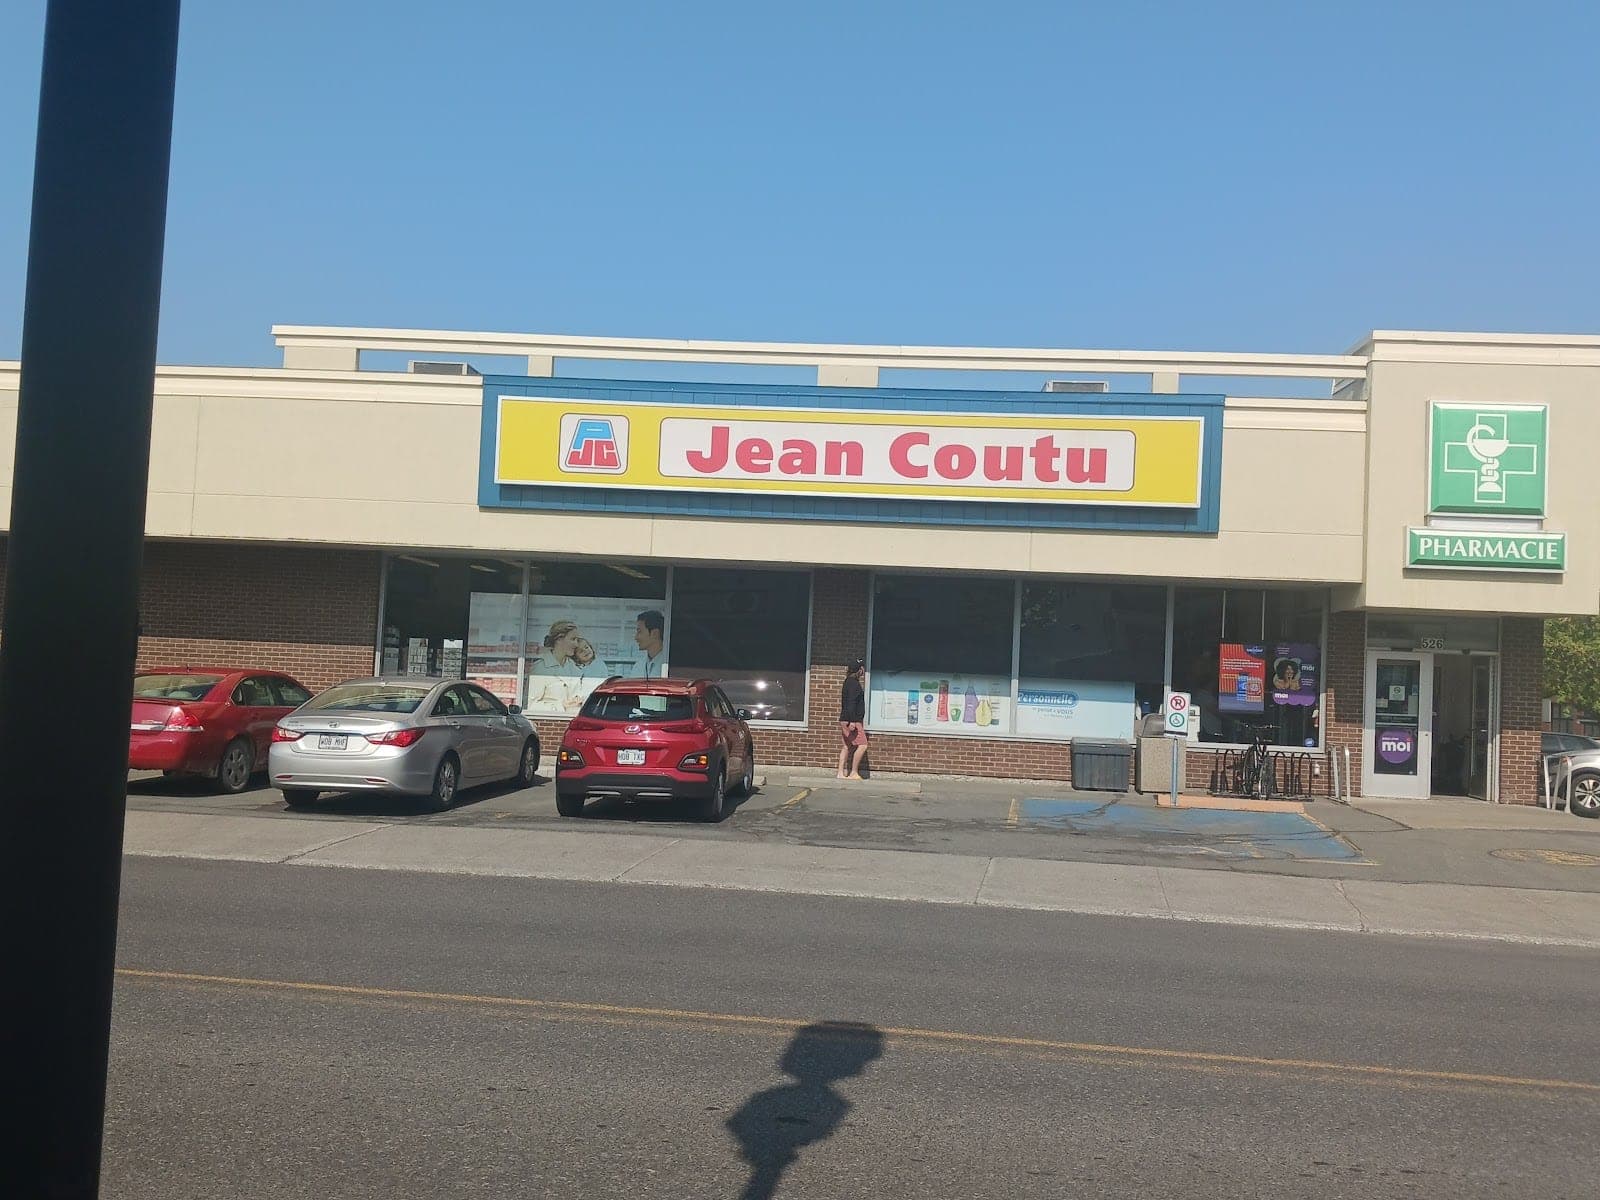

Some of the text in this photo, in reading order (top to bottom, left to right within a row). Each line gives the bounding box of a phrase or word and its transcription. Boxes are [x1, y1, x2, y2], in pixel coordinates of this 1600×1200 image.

[686, 426, 1107, 483] Jean Coutu
[1419, 538, 1558, 560] PHARMACIE
[1422, 638, 1443, 649] 526
[1017, 692, 1073, 705] Personnelle
[1381, 738, 1411, 753] moi
